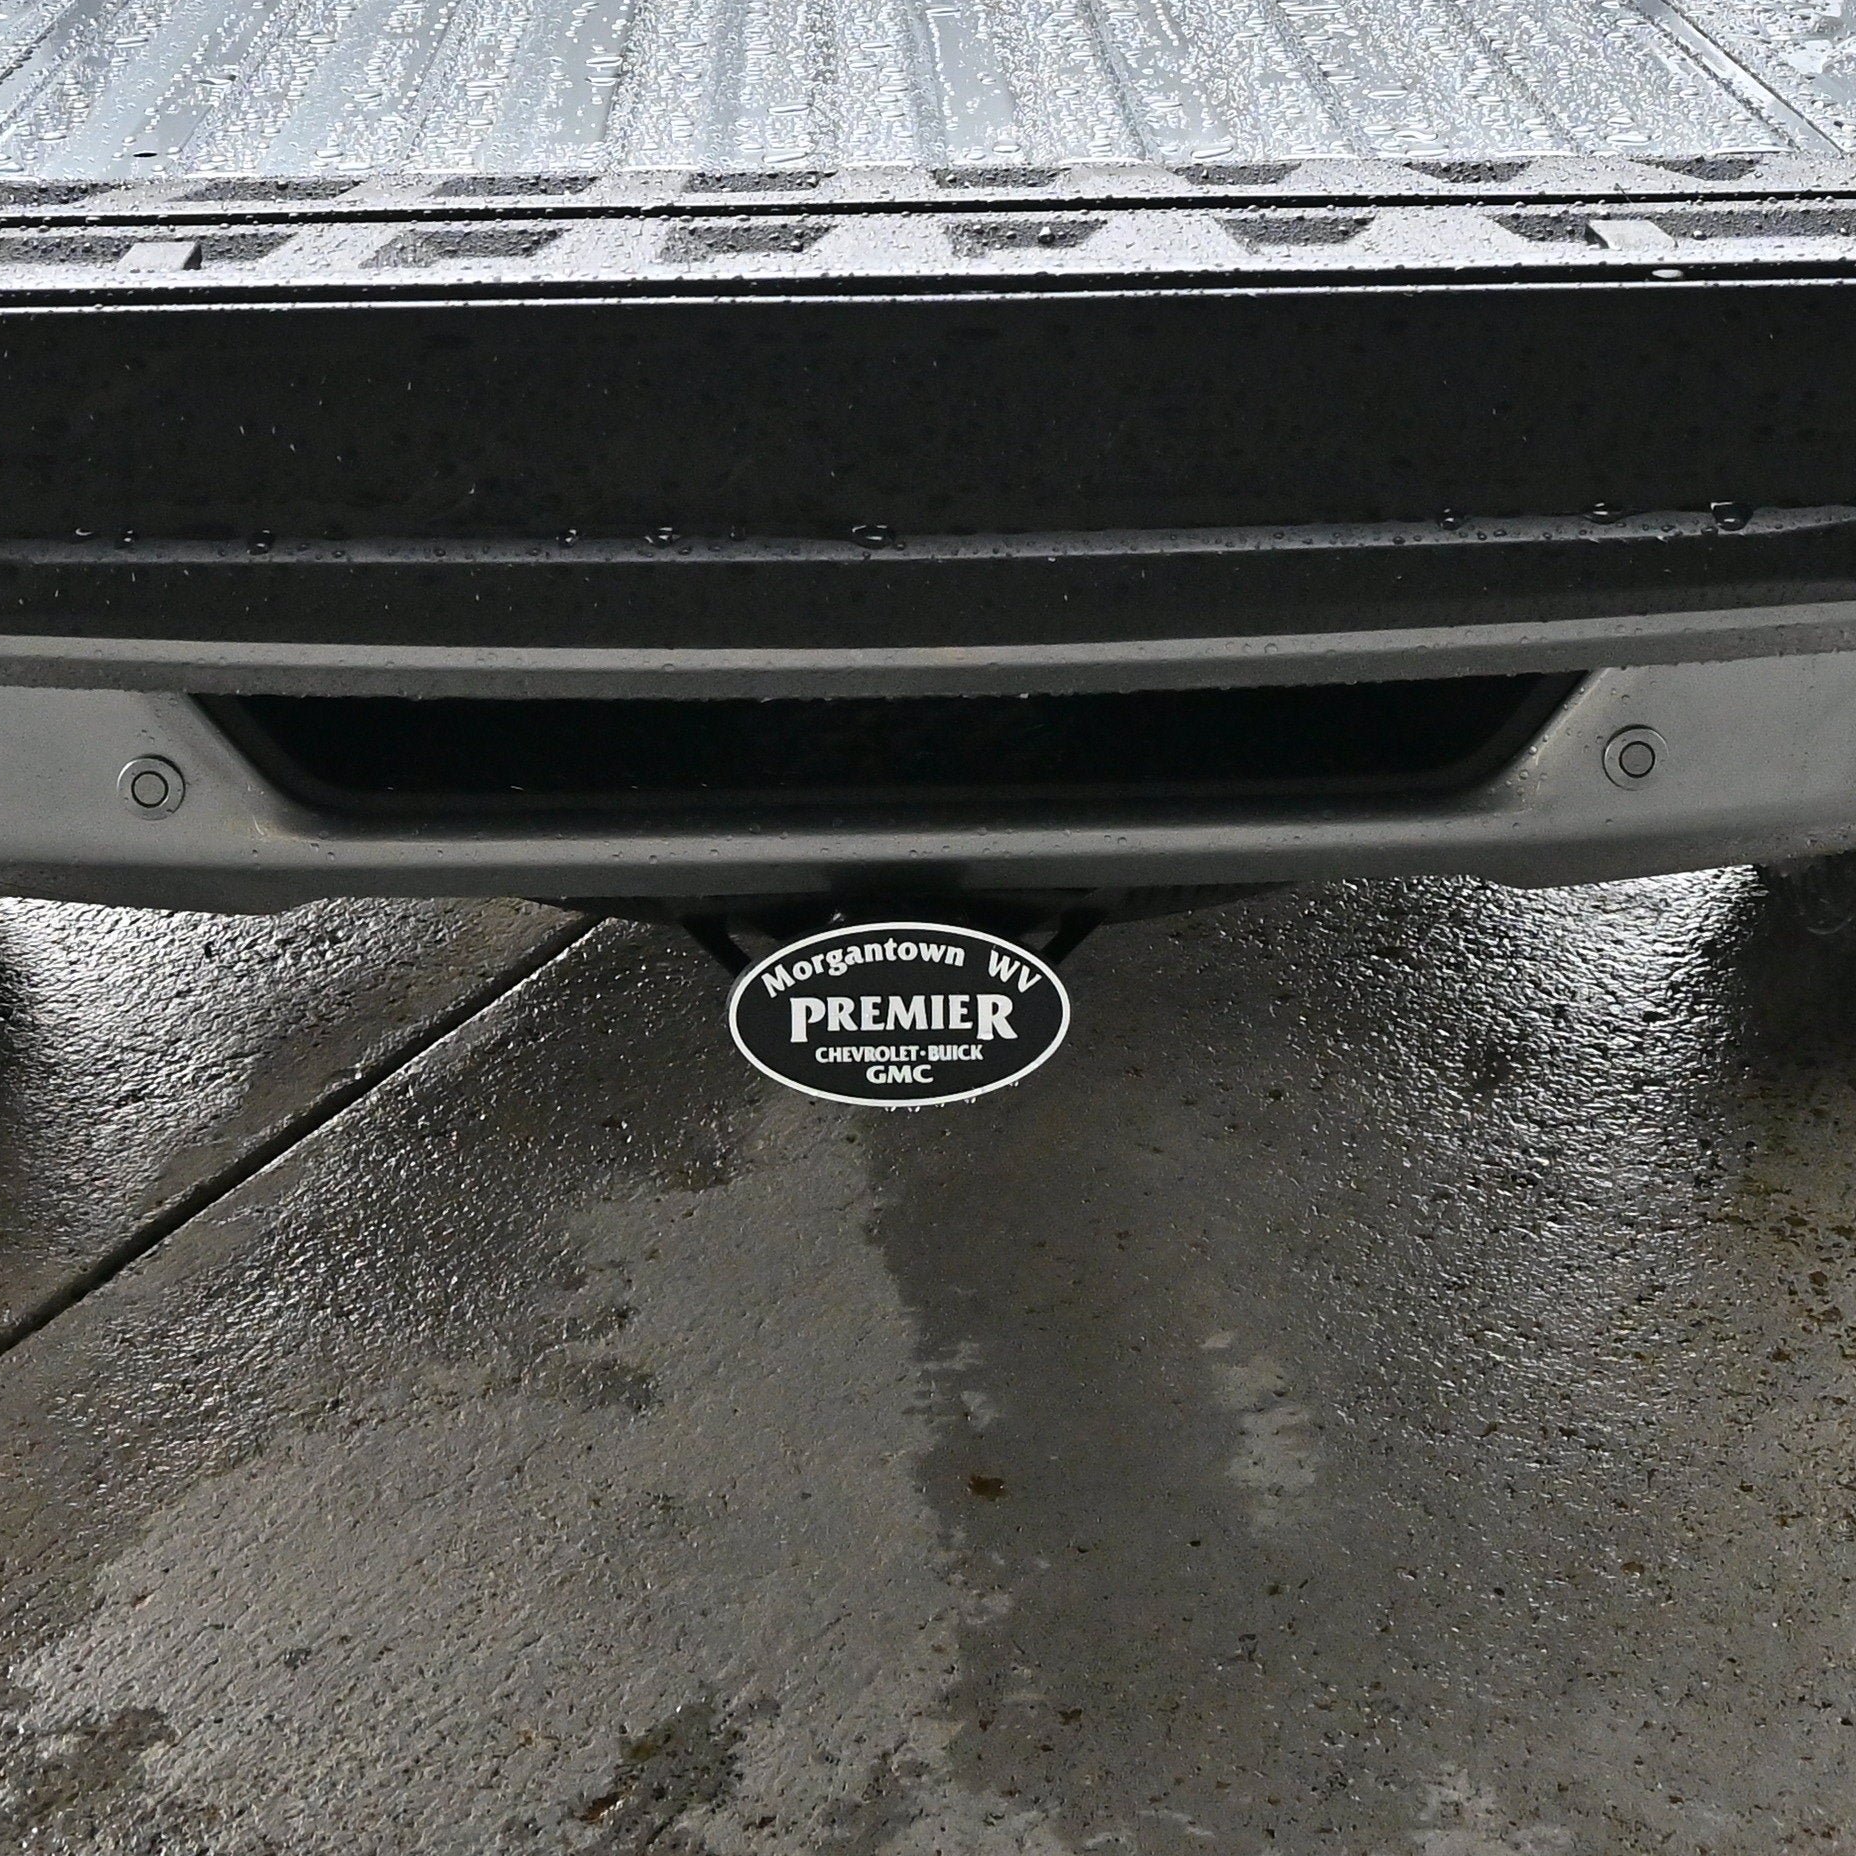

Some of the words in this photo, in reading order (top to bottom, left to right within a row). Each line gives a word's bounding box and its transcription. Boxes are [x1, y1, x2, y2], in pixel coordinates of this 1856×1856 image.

[761, 937, 966, 998] Morgantown
[987, 949, 1043, 993] WV
[789, 993, 1018, 1043] PREMIER
[865, 1064, 934, 1085] GMC
